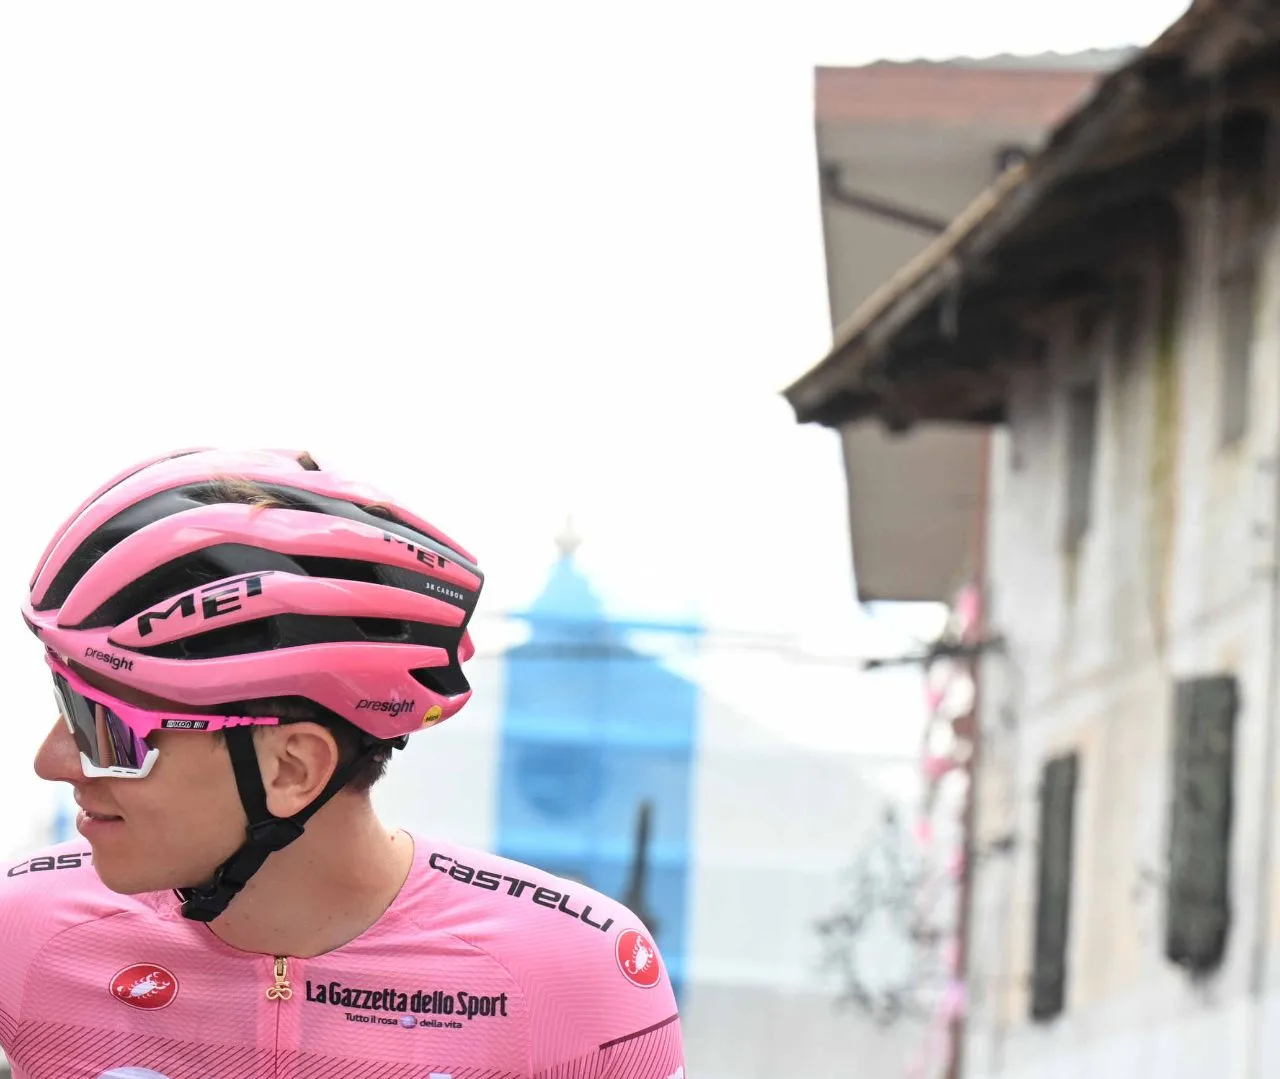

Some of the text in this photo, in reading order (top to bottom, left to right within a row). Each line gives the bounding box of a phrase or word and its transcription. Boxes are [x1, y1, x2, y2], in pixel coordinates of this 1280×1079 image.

[436, 585, 465, 601] CARBON
[136, 571, 278, 638] MET
[84, 647, 134, 672] presight
[355, 698, 416, 717] presight
[305, 980, 508, 1020] La Gazzetta dello Sport
[344, 1012, 370, 1024] Tutto
[377, 1017, 398, 1026] rosa
[419, 1018, 463, 1029] della vita
